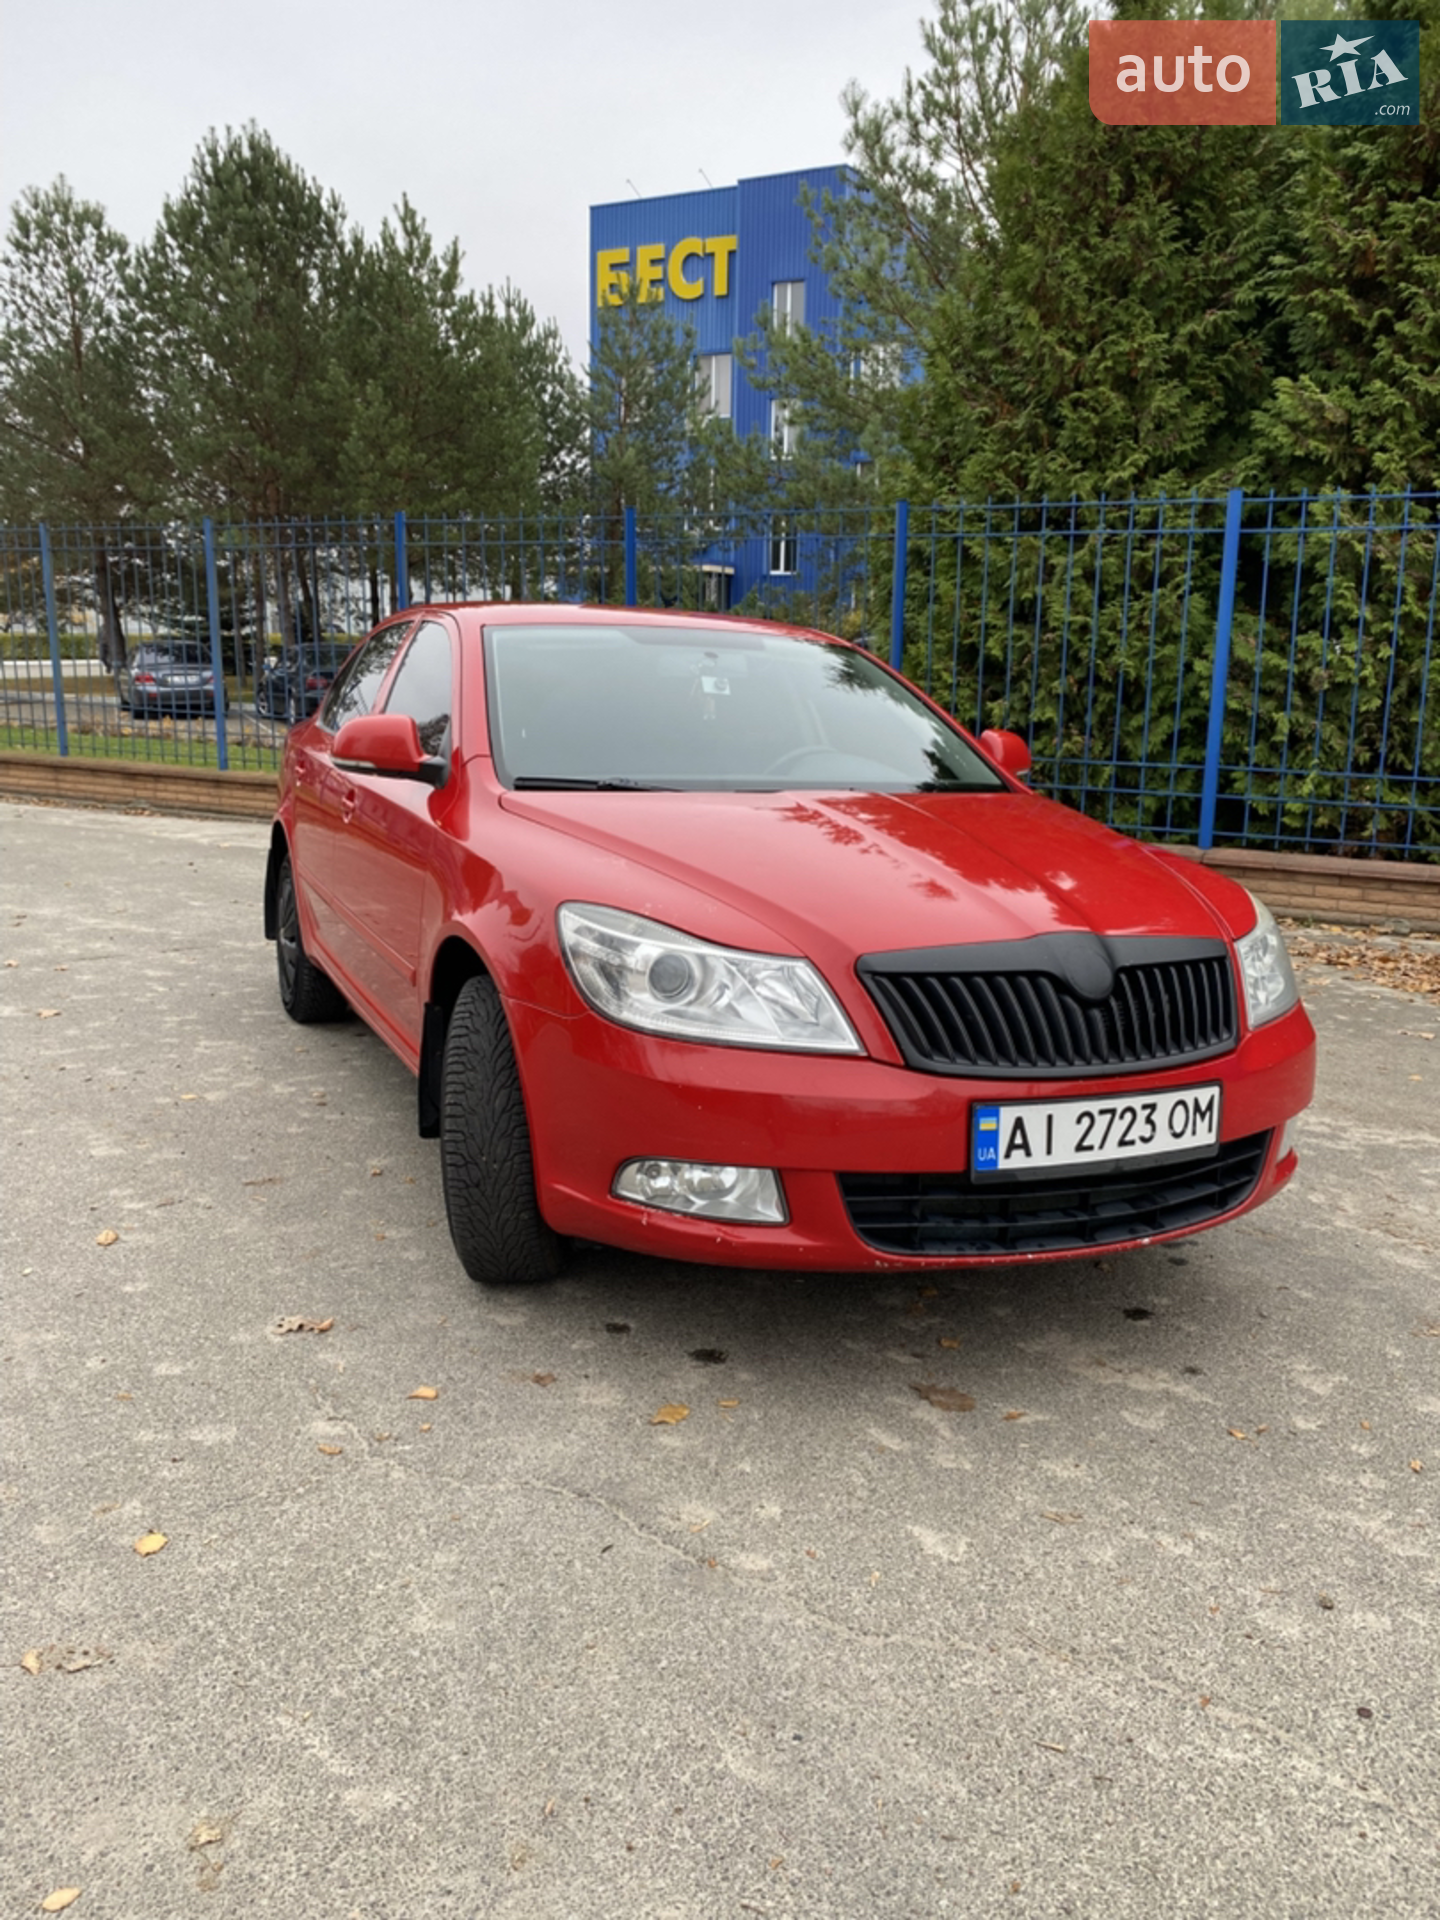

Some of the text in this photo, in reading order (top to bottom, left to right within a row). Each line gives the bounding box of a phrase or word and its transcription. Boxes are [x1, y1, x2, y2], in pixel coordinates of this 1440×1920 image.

[596, 234, 737, 307] БЕСТ
[977, 1147, 997, 1162] UA
[1003, 1094, 1216, 1160] AI 2723 OM
